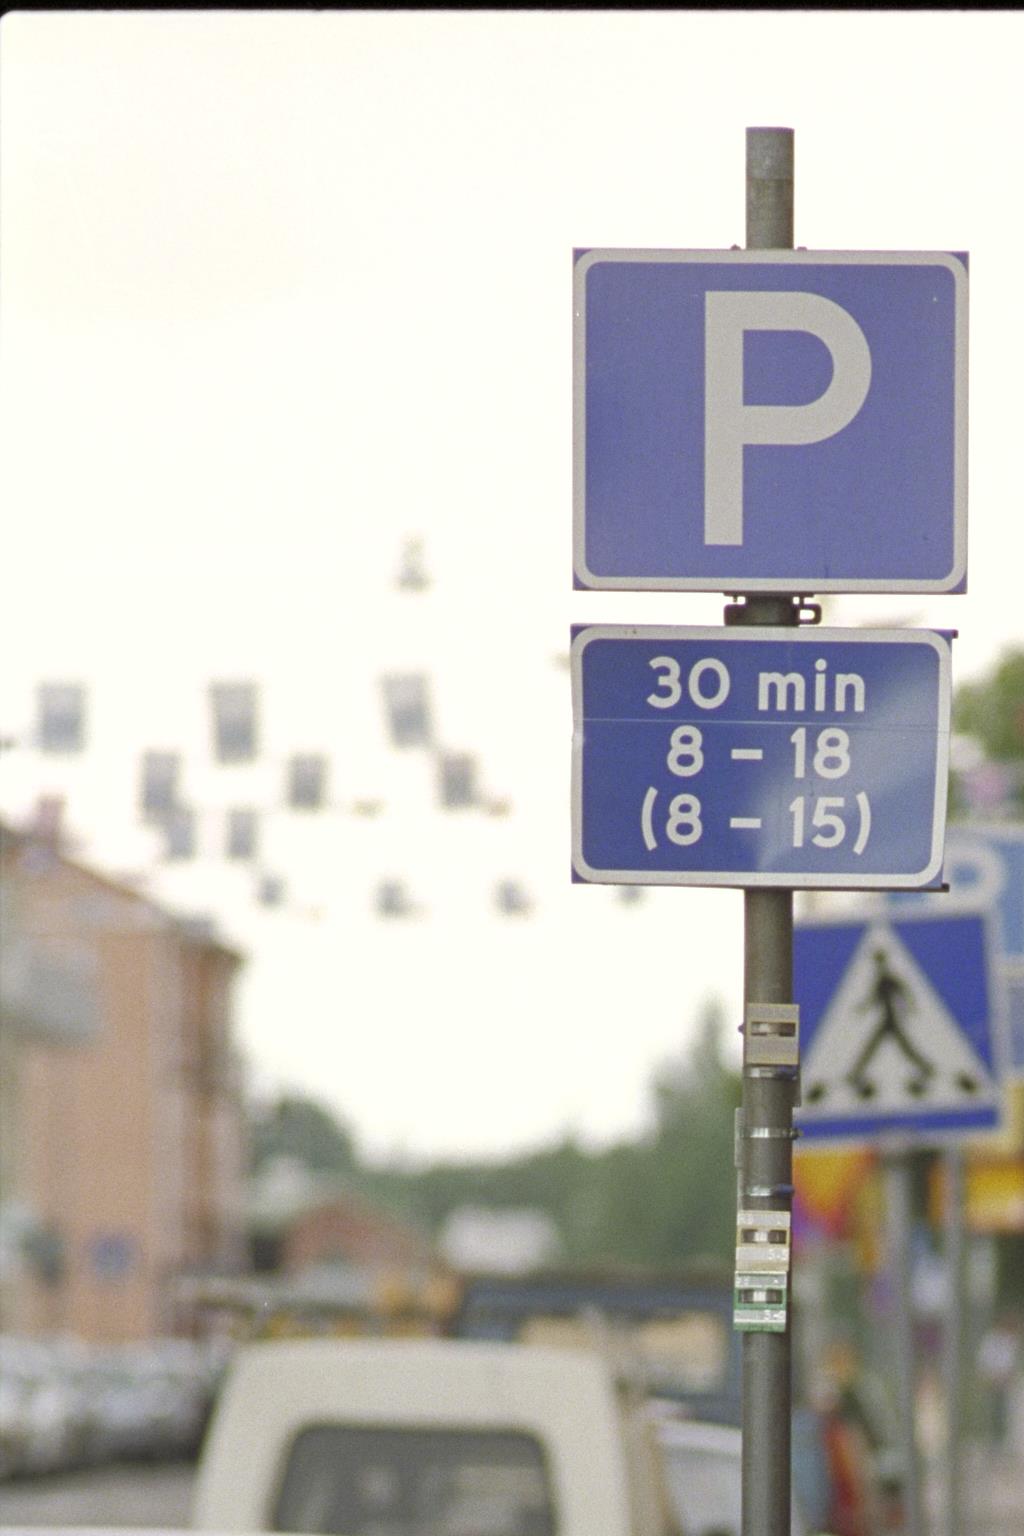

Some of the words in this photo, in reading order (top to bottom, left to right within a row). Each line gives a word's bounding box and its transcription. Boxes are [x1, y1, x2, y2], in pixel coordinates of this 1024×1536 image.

[704, 291, 872, 546] P
[646, 656, 731, 709] 30
[757, 658, 866, 712] min
[666, 725, 704, 777] 8
[790, 728, 851, 779] 18
[641, 786, 703, 850] (8
[788, 791, 872, 855] 15)
